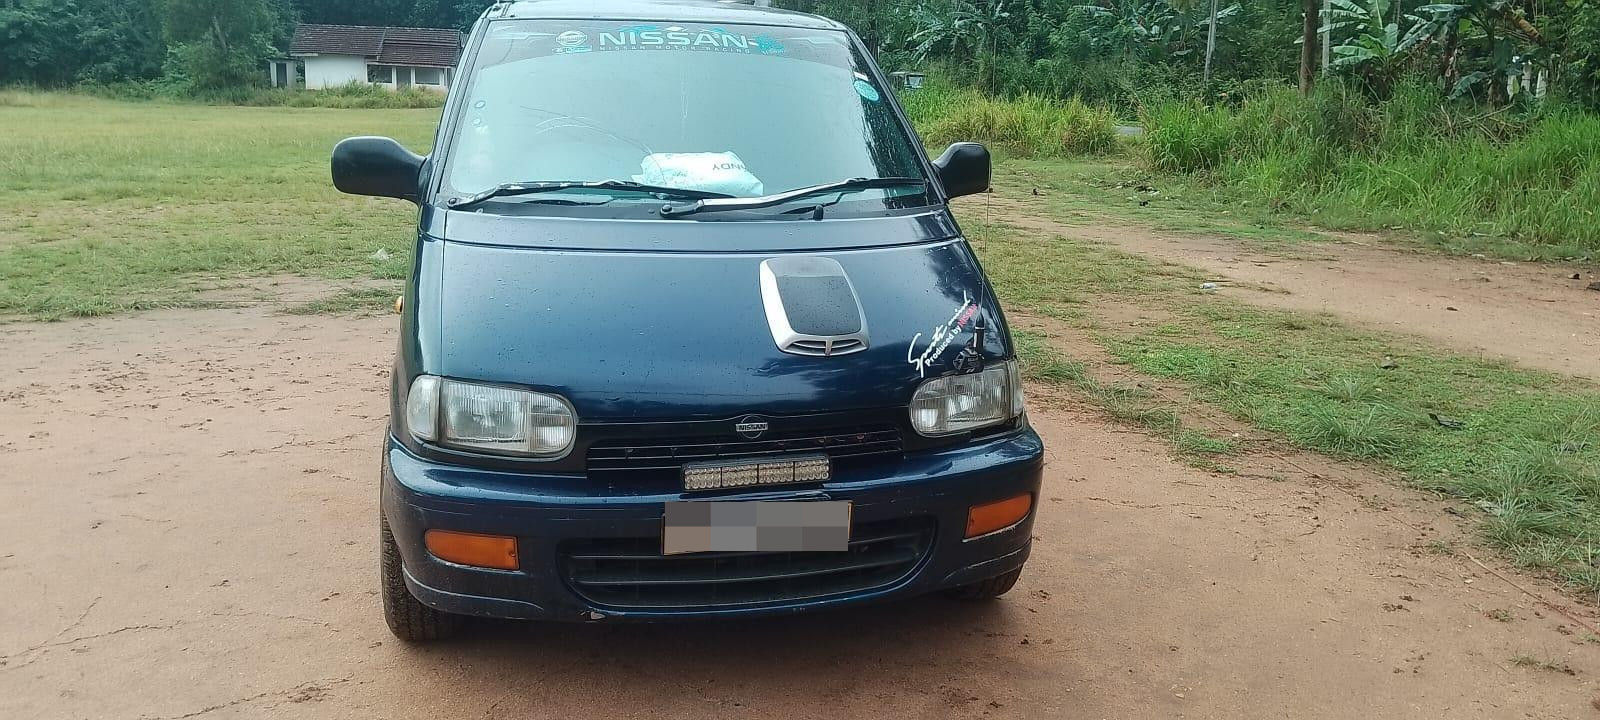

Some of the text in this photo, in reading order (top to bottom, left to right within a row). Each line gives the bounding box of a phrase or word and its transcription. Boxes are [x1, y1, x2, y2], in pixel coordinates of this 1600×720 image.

[599, 31, 748, 49] NISSAN
[705, 46, 751, 54] RACING
[924, 332, 955, 367] Produced
[738, 423, 766, 431] NISSAN
